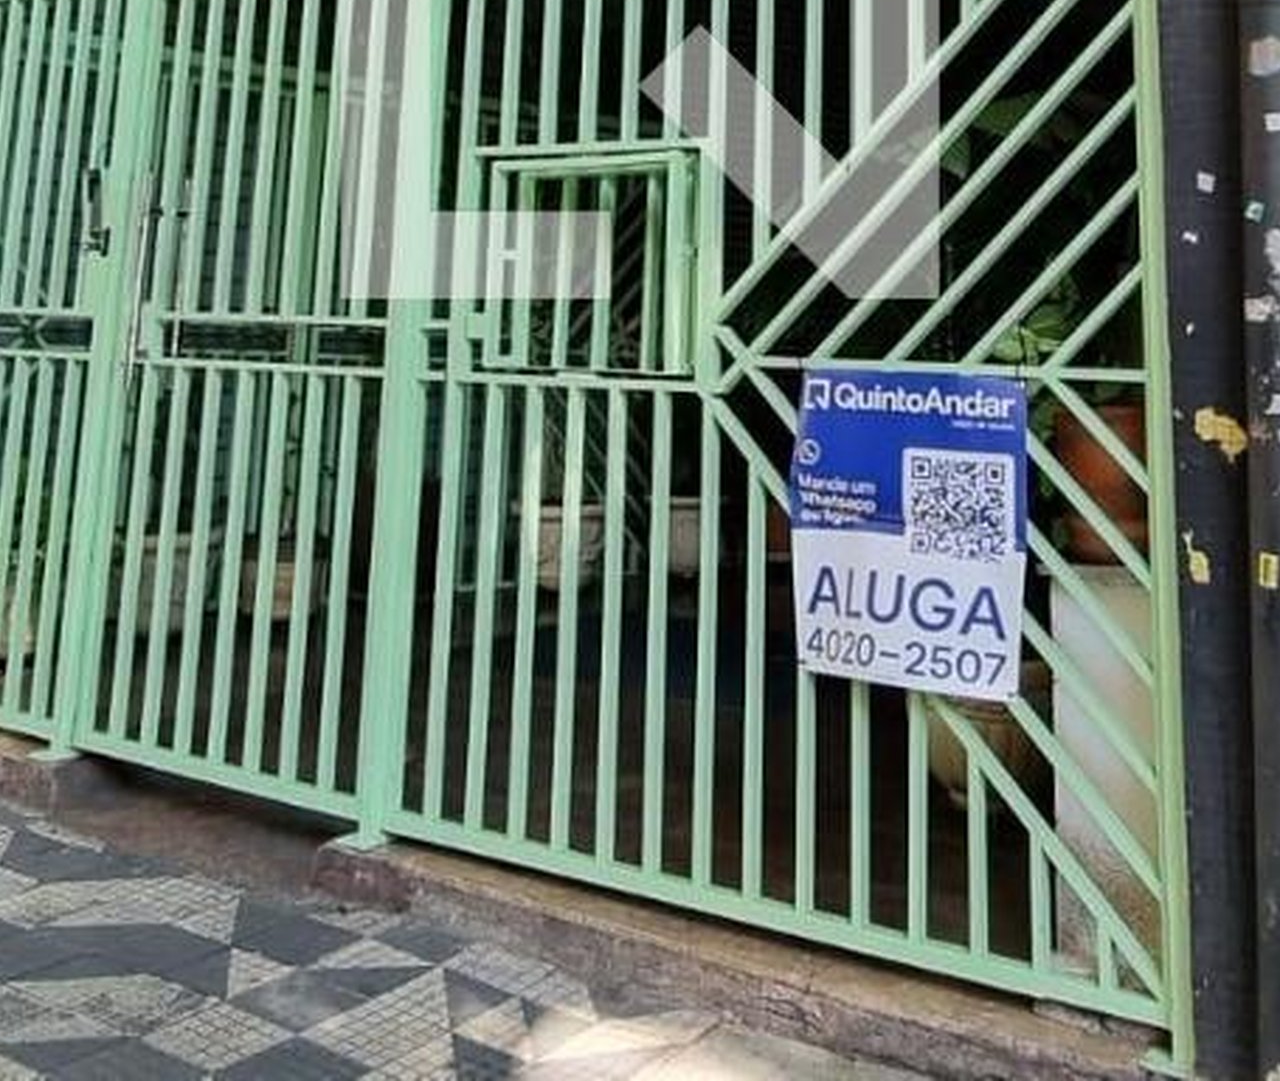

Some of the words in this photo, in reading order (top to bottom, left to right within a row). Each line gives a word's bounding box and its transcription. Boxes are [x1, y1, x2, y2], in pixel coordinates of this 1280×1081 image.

[833, 381, 1017, 419] QuintoAndar
[807, 565, 1007, 641] ALUGA
[806, 627, 1008, 687] 4020-2507
